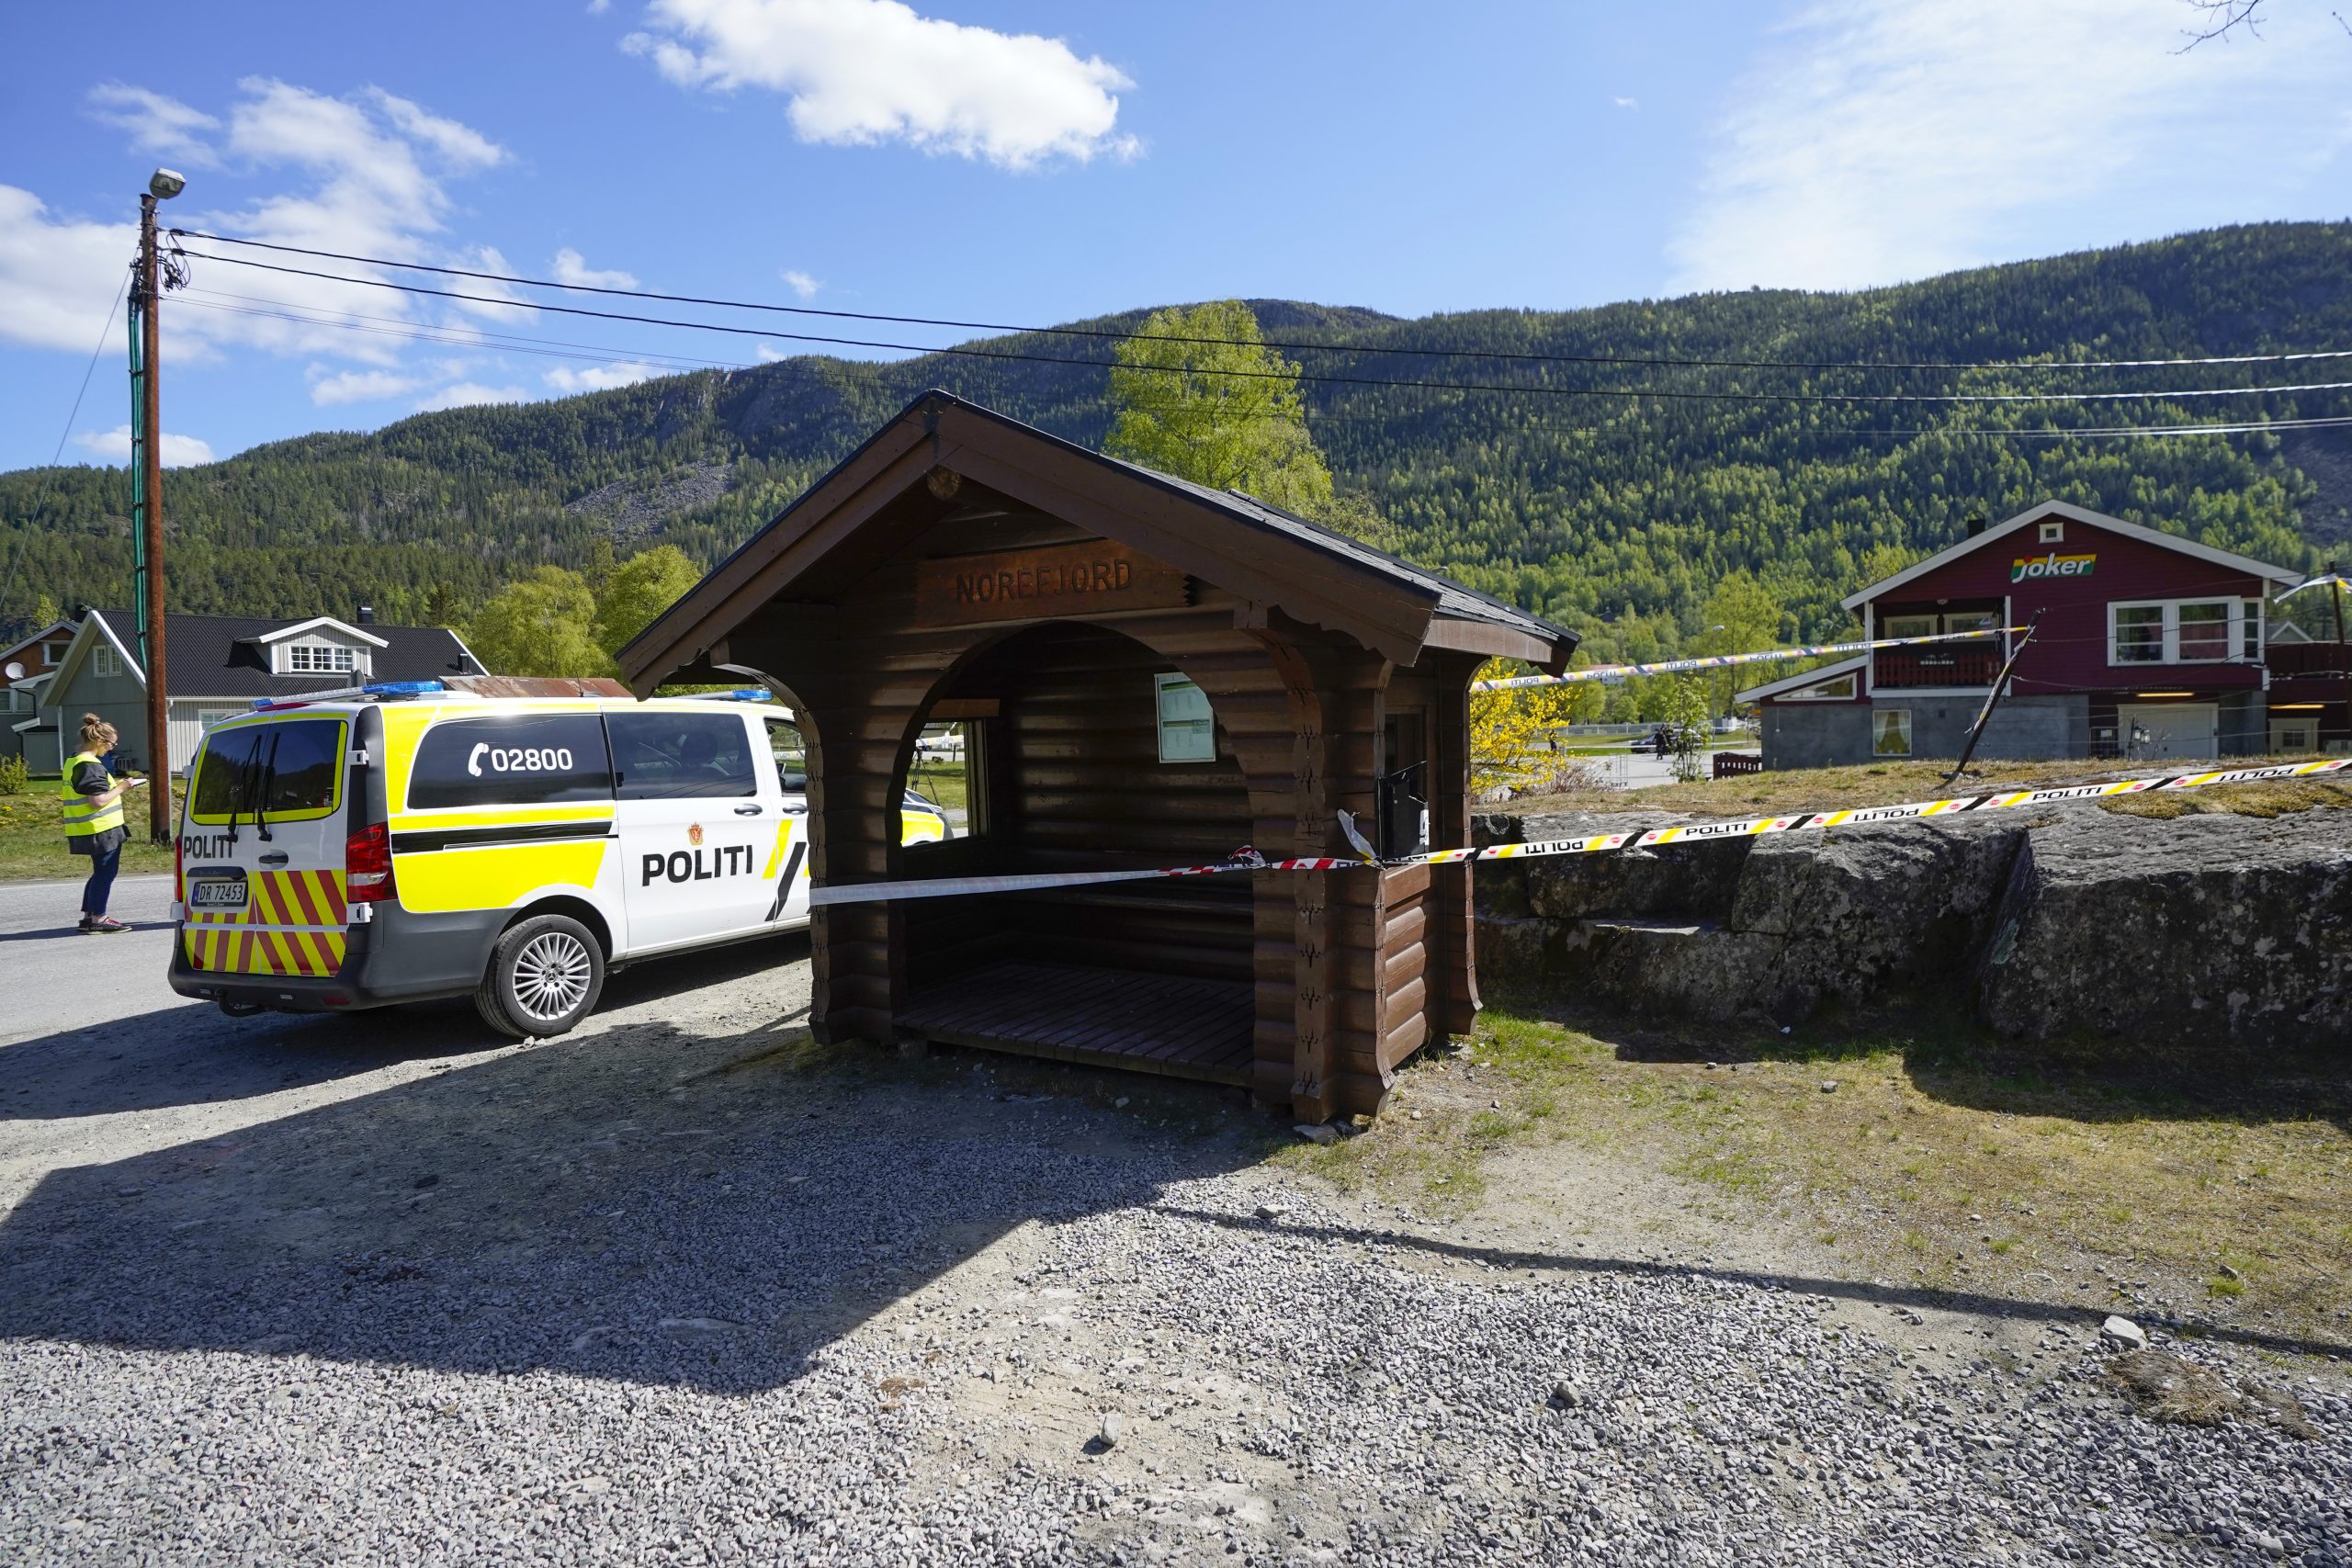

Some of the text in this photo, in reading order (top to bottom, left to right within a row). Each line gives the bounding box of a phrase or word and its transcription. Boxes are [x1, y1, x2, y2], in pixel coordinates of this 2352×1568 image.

[2011, 552, 2091, 584] joker
[956, 558, 1133, 604] NOREFJORD
[491, 748, 573, 772] 02800
[2219, 767, 2293, 782] POLITI
[2032, 785, 2102, 801] POLITI
[1854, 807, 1919, 822] POLITI
[1686, 822, 1747, 836] POLITI
[183, 834, 232, 860] POLITI
[1525, 840, 1584, 855] POLITI
[641, 844, 753, 887] POLITI
[199, 885, 243, 900] DR 72453
